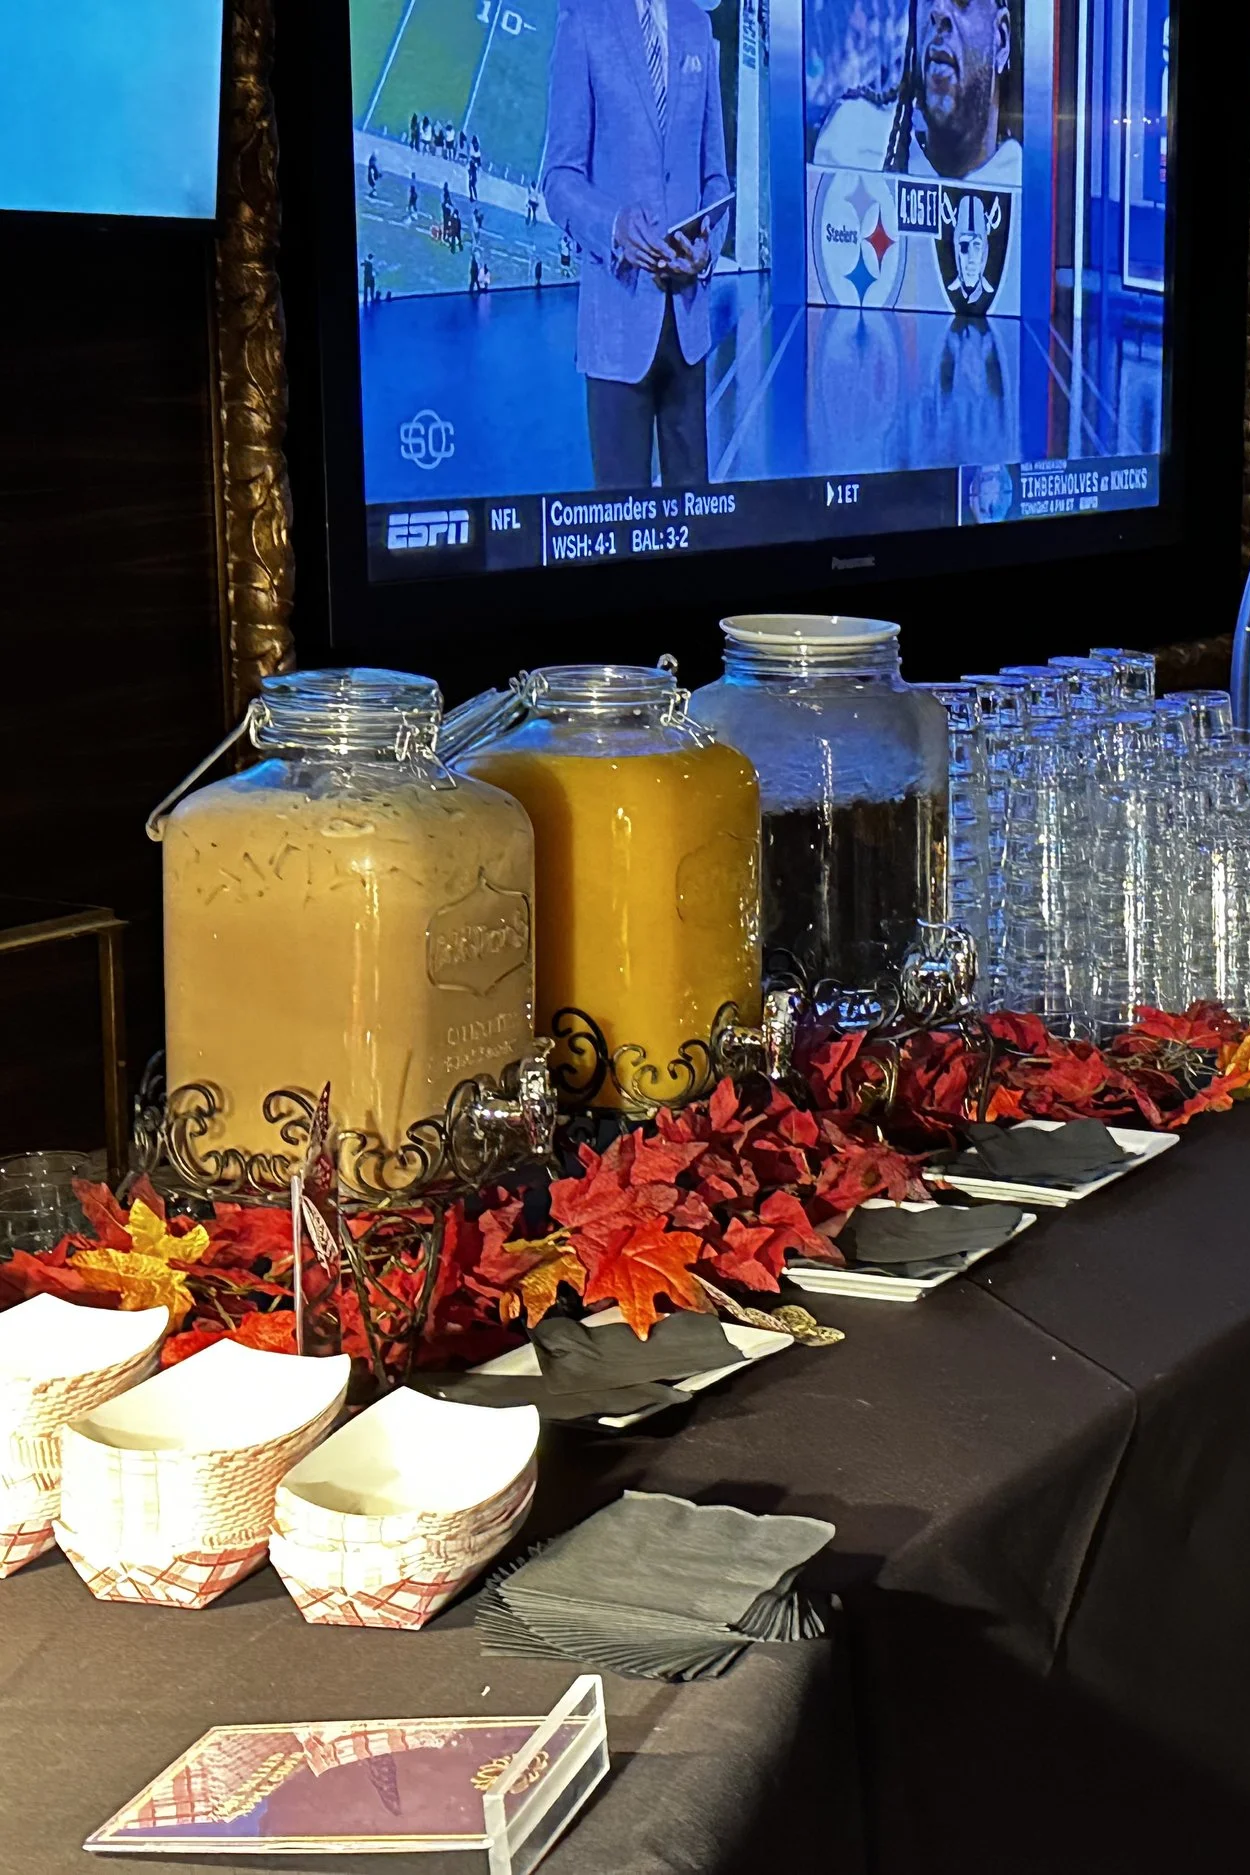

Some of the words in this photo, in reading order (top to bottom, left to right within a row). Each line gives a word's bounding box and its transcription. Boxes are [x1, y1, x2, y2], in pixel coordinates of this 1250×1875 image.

[900, 187, 925, 226] 4:05
[926, 189, 940, 227] ET
[825, 223, 858, 245] Steelers
[1020, 471, 1098, 499] TIMBERWOLVES
[1110, 467, 1148, 491] KNICKS
[491, 507, 521, 531] NFL
[550, 496, 657, 527] Commanders
[662, 498, 679, 518] vs
[684, 492, 736, 517] Ravens
[387, 509, 470, 550] ESPN
